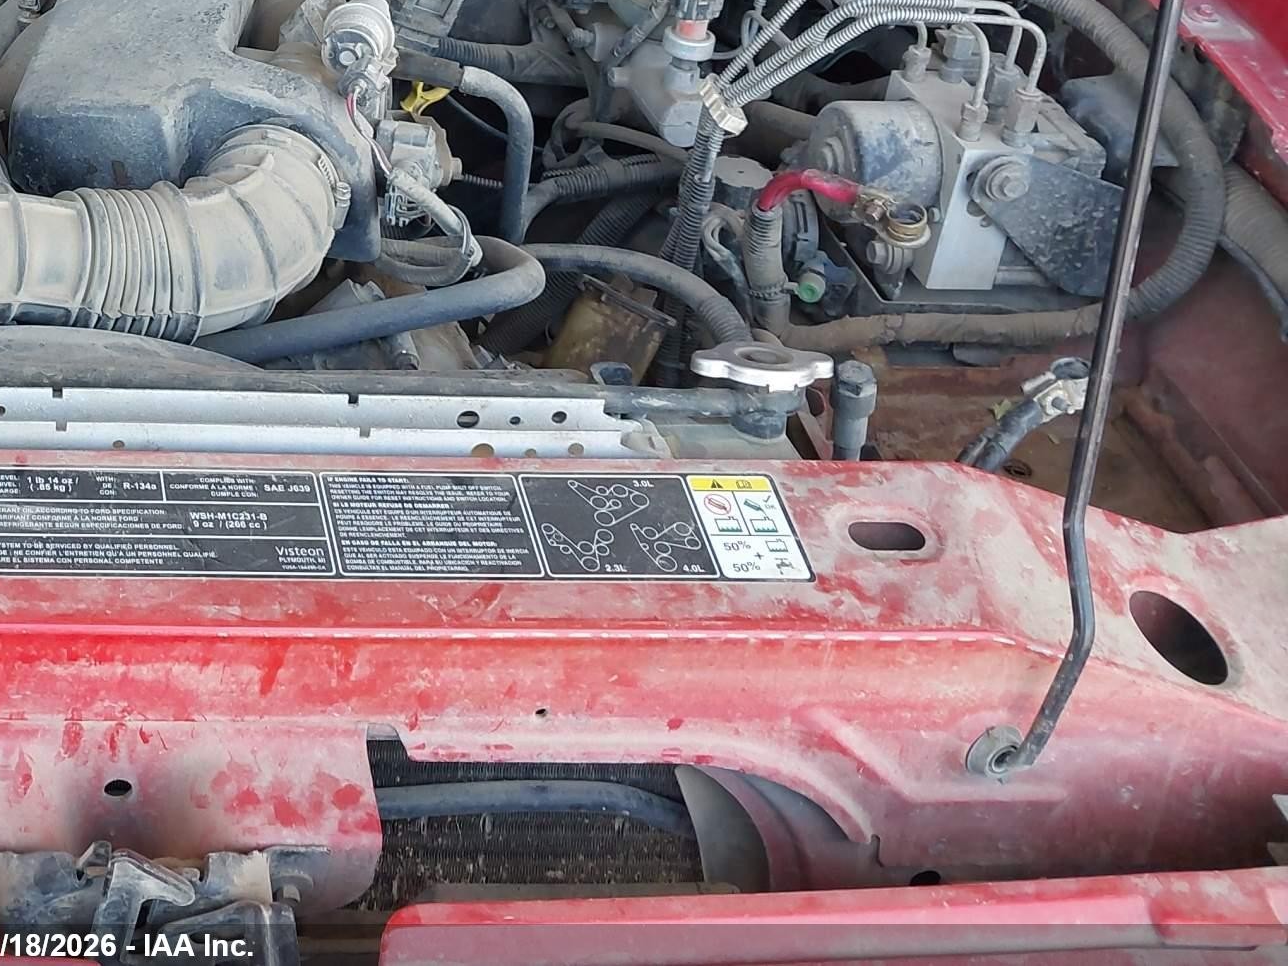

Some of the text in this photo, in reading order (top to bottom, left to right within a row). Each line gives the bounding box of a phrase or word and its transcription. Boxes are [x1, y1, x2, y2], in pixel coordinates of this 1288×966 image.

[123, 482, 157, 490] R-134a
[723, 541, 752, 551] 50%
[275, 546, 324, 556] Visteon
[604, 564, 628, 572] 2.3L
[682, 564, 706, 572] 4.0L
[732, 562, 760, 573] 50%
